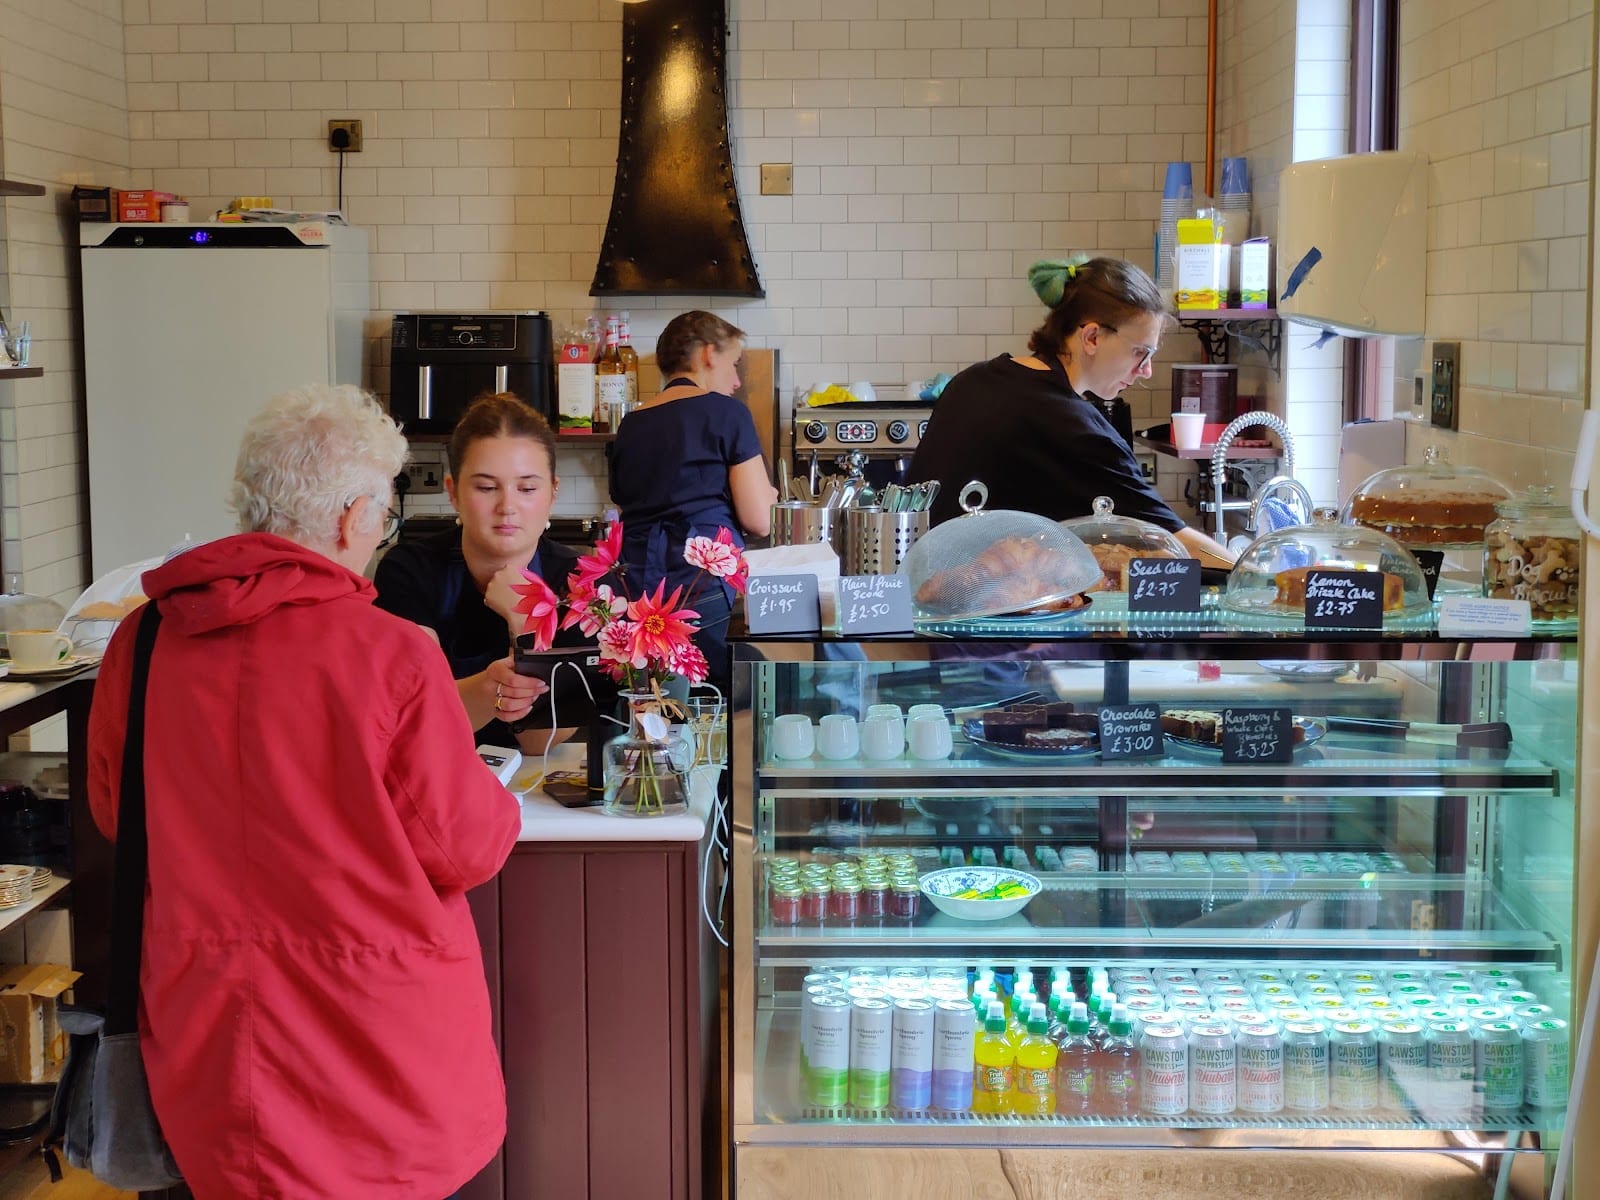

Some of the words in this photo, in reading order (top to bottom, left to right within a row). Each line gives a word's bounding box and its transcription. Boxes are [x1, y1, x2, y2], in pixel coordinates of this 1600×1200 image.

[1129, 559, 1162, 577] Seed
[1164, 561, 1190, 575] Cake
[1507, 555, 1542, 587] Dog
[748, 578, 804, 596] Croissant
[1308, 572, 1356, 588] Lemon
[1133, 579, 1181, 600] £2.75
[1305, 585, 1346, 599] Drizzle
[1347, 587, 1377, 601] Cake
[759, 597, 797, 618] £1.95
[848, 603, 891, 624] £2.50
[1314, 600, 1358, 617] £2.75
[1100, 708, 1157, 722] Chocolate
[1224, 709, 1272, 727] Raspberry
[1103, 721, 1152, 736] Brownies
[1111, 736, 1154, 754] £3.00
[1235, 740, 1280, 759] £3.25
[1146, 1048, 1184, 1062] CAWSTON
[1195, 1048, 1234, 1061] CAWSTON
[1241, 1047, 1280, 1061] CAWSTON
[1285, 1045, 1325, 1058] CAWSTON
[1337, 1046, 1376, 1058] CAWSTON
[1431, 1044, 1471, 1056] CAWSTON
